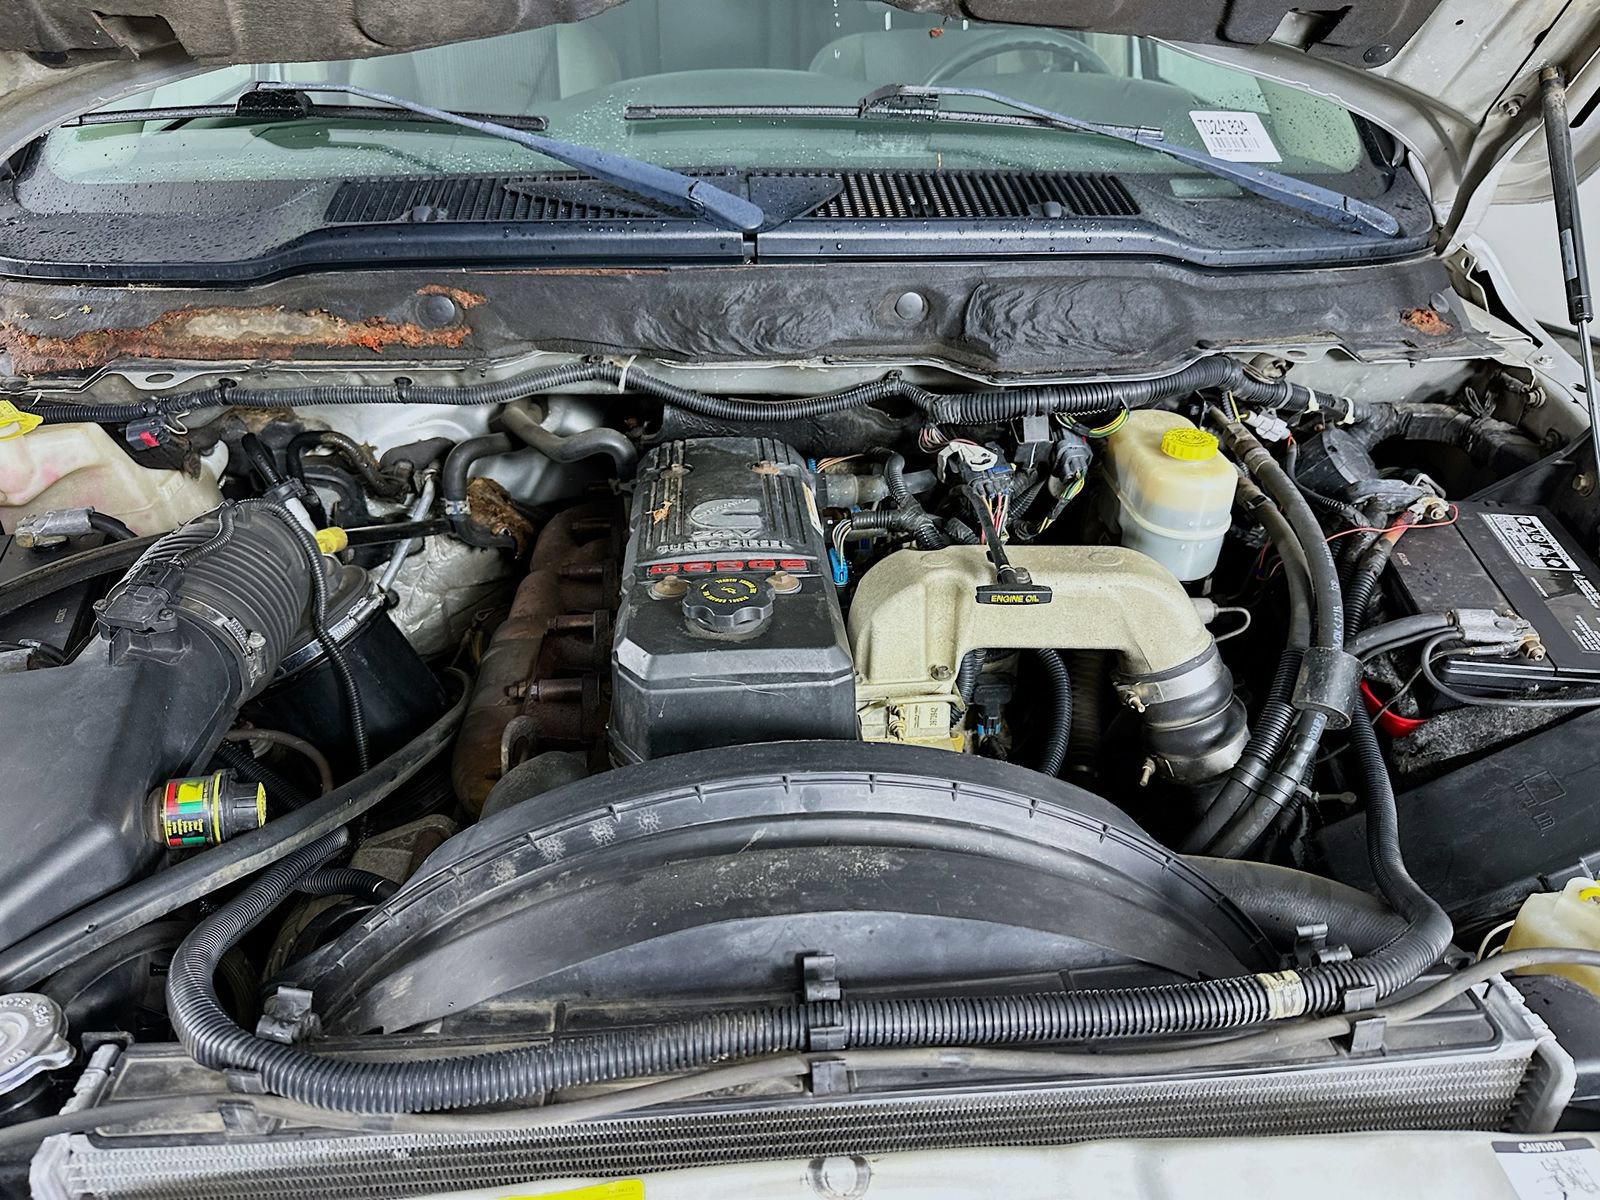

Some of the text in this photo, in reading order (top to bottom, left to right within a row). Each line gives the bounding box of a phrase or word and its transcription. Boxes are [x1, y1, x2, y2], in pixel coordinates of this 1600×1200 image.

[990, 594, 1039, 603] ENGINE OIL
[1518, 1141, 1566, 1153] CAUTION
